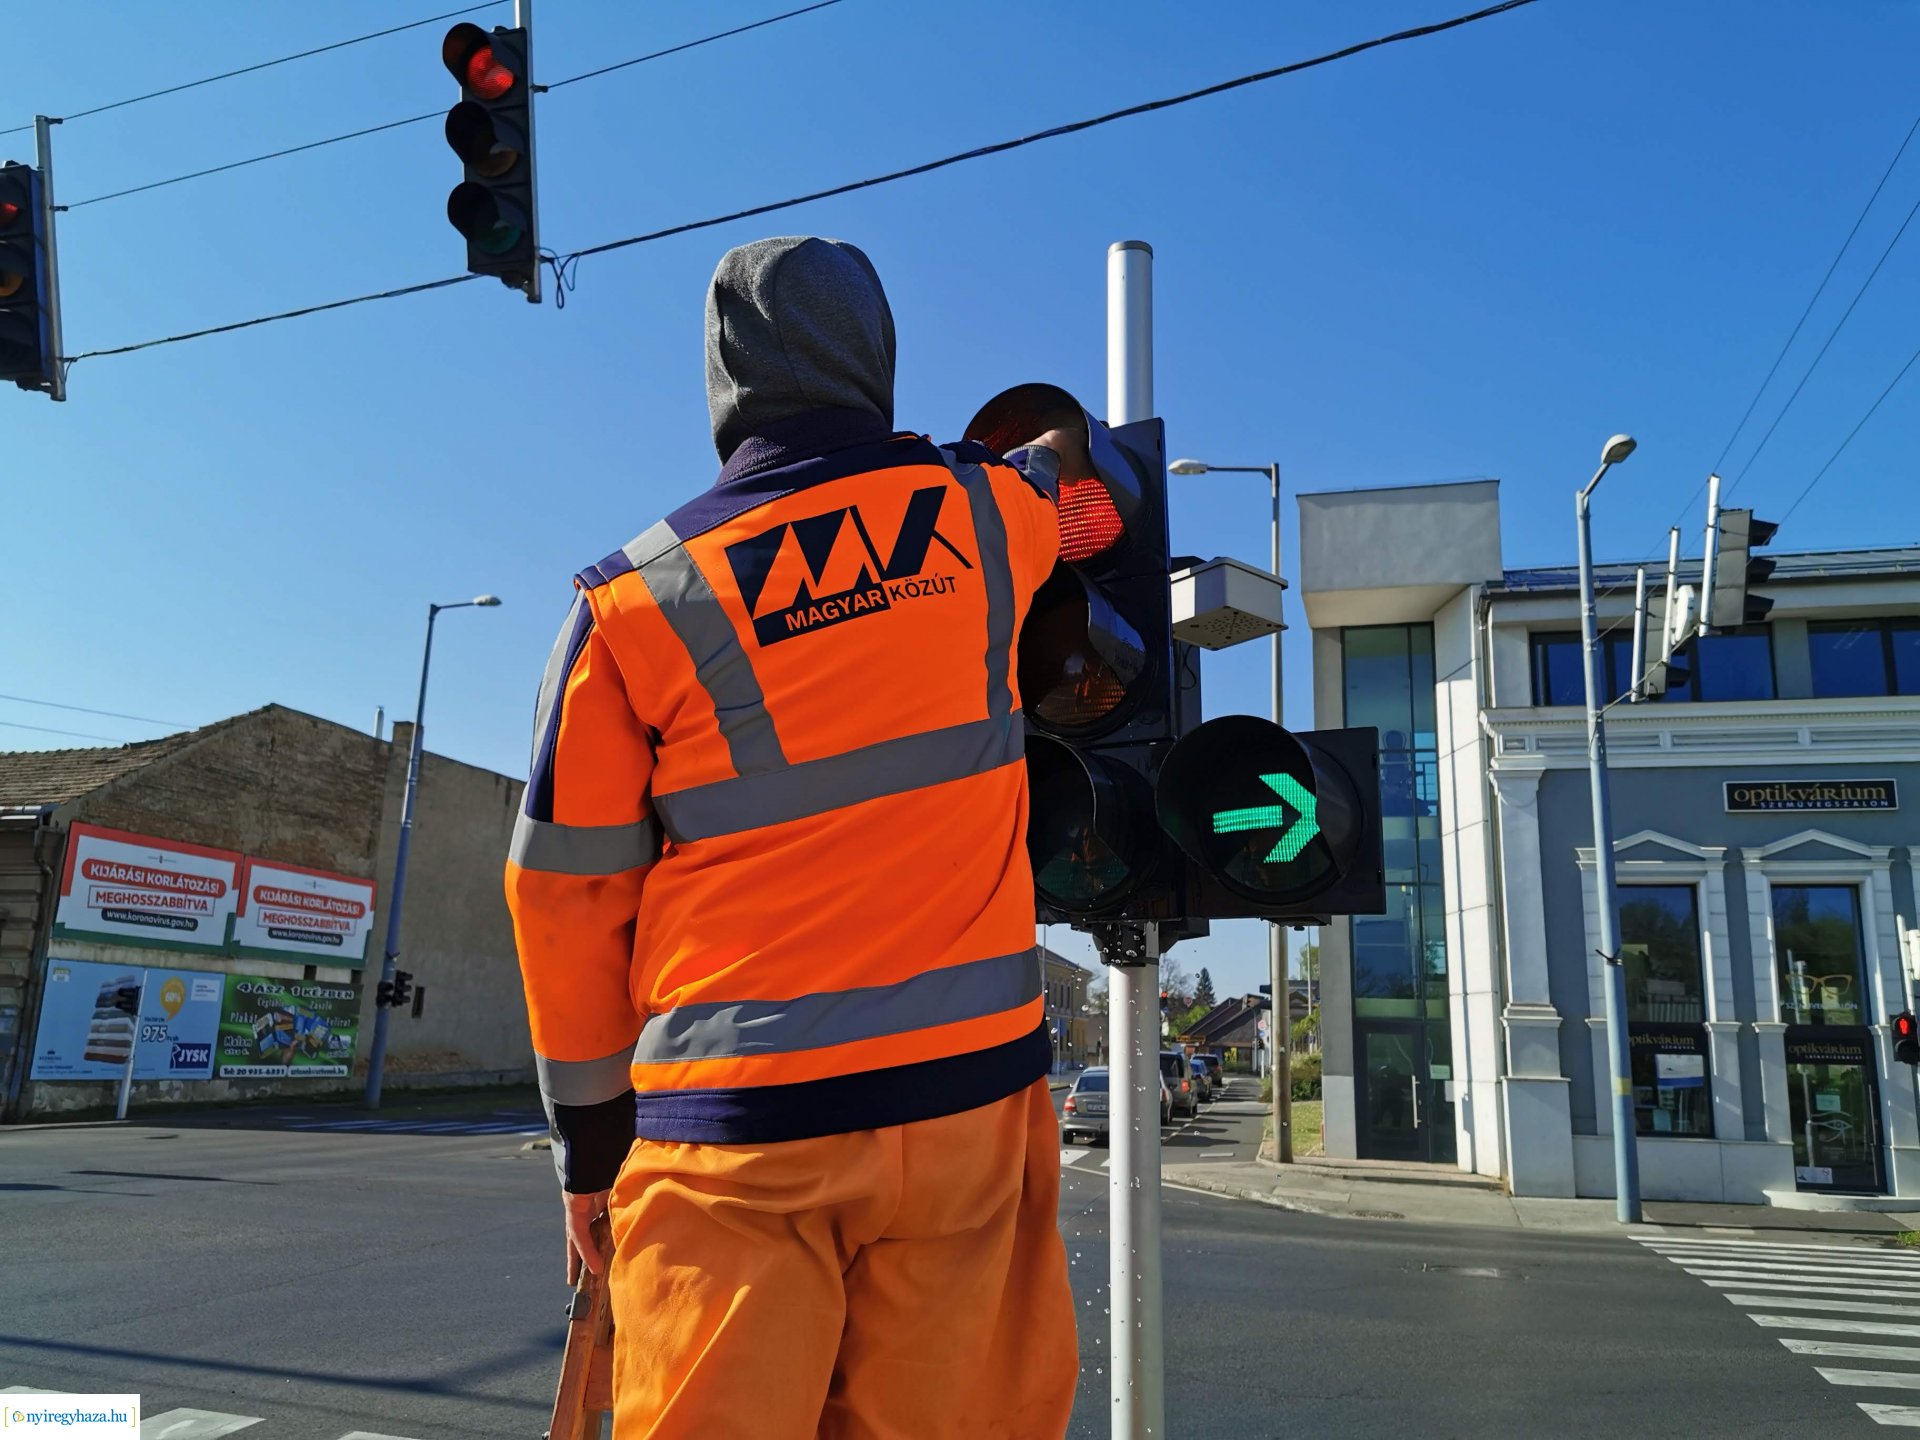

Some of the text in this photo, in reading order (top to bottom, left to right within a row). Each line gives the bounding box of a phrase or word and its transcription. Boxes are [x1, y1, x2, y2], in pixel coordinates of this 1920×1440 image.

[785, 573, 957, 631] MAGYAR KÖZÚT
[90, 863, 145, 882] KIJÁRÁSI
[96, 890, 208, 911] MEGHOSSZABBÍTVA
[260, 889, 301, 905] KIJÁRÁSI
[106, 910, 195, 928] www.koronavirus.gov.hu
[262, 911, 351, 931] MEGHOSSZABBÍTVA
[142, 1024, 168, 1042] 975
[178, 1049, 208, 1062] JYSK
